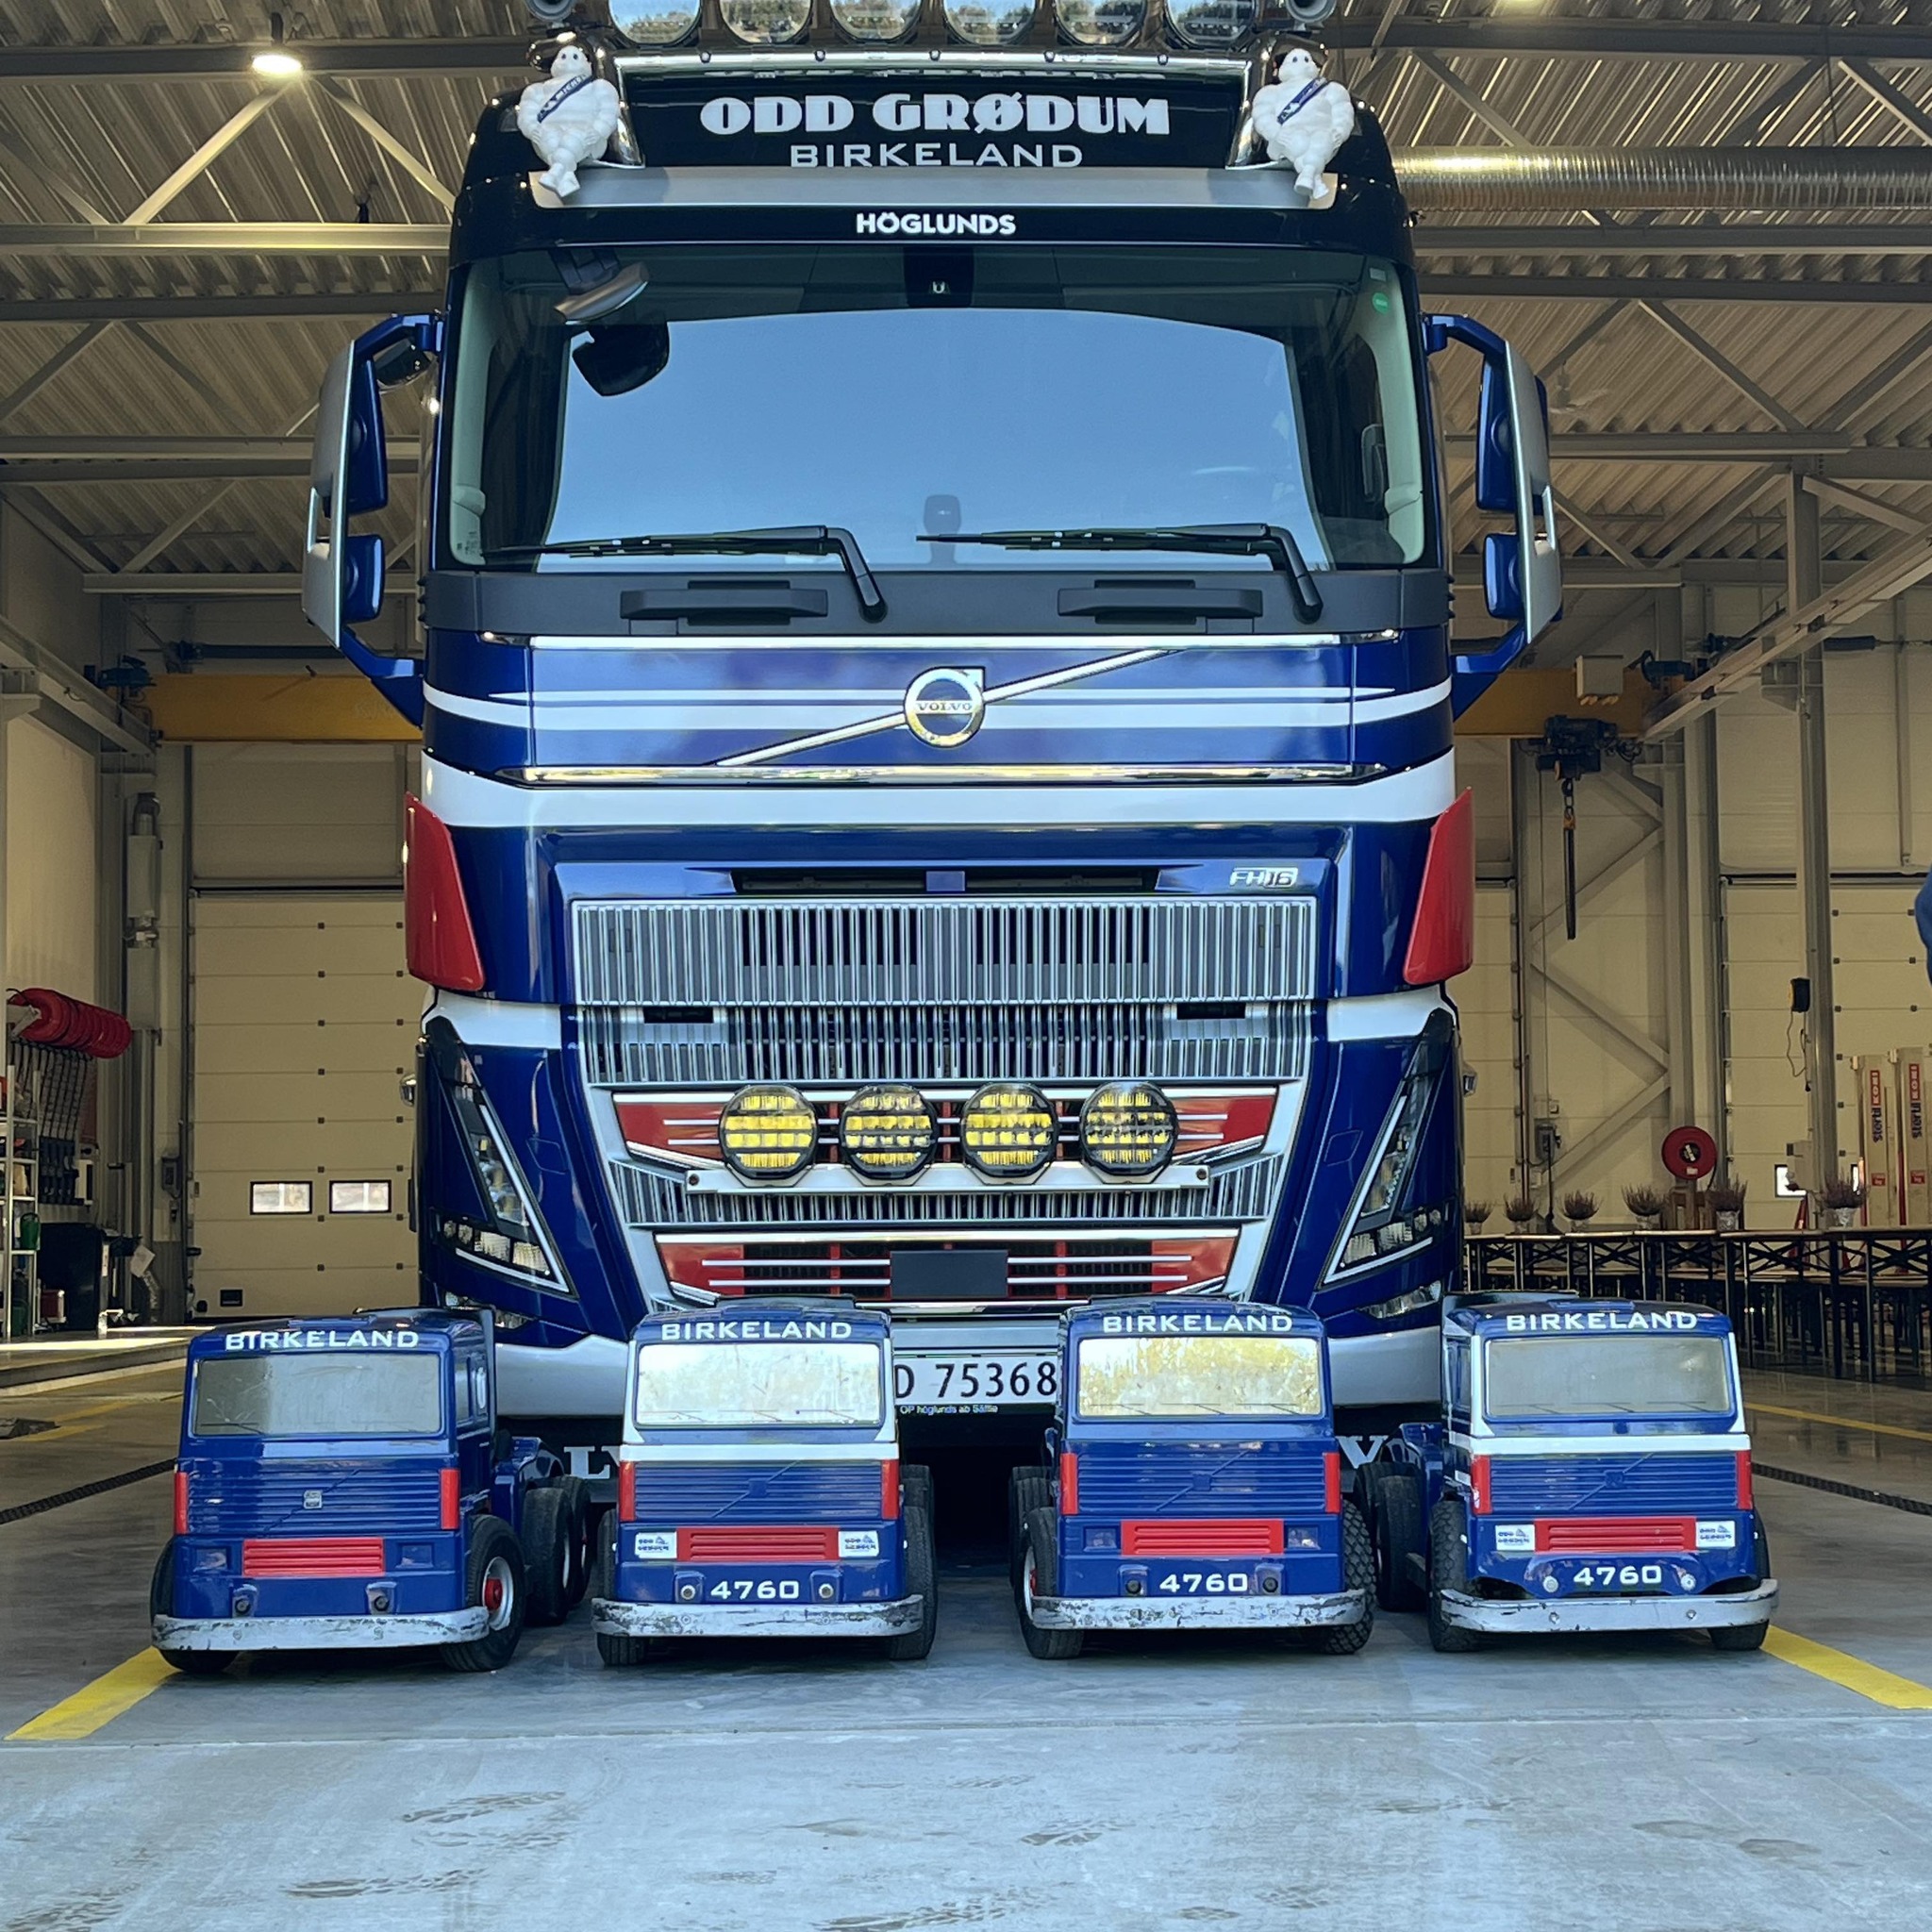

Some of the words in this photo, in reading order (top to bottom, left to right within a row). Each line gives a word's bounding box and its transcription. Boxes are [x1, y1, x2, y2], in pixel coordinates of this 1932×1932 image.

[700, 96, 855, 135] ODD
[873, 92, 1170, 135] GRØDUM
[791, 142, 1084, 168] BIRKELAND
[856, 212, 1017, 236] HÖGLUNDS
[917, 702, 972, 711] VOLVO
[1229, 867, 1298, 887] FH16
[660, 1321, 852, 1341] BIRKELAND
[1102, 1314, 1293, 1333] BIRKELAND
[1506, 1312, 1698, 1331] BIRKELAND
[225, 1330, 420, 1351] BIRKELAND
[935, 1361, 1058, 1398] 75368
[1158, 1574, 1248, 1593] 4760
[1573, 1565, 1662, 1585] 4760
[709, 1580, 800, 1600] 4760
